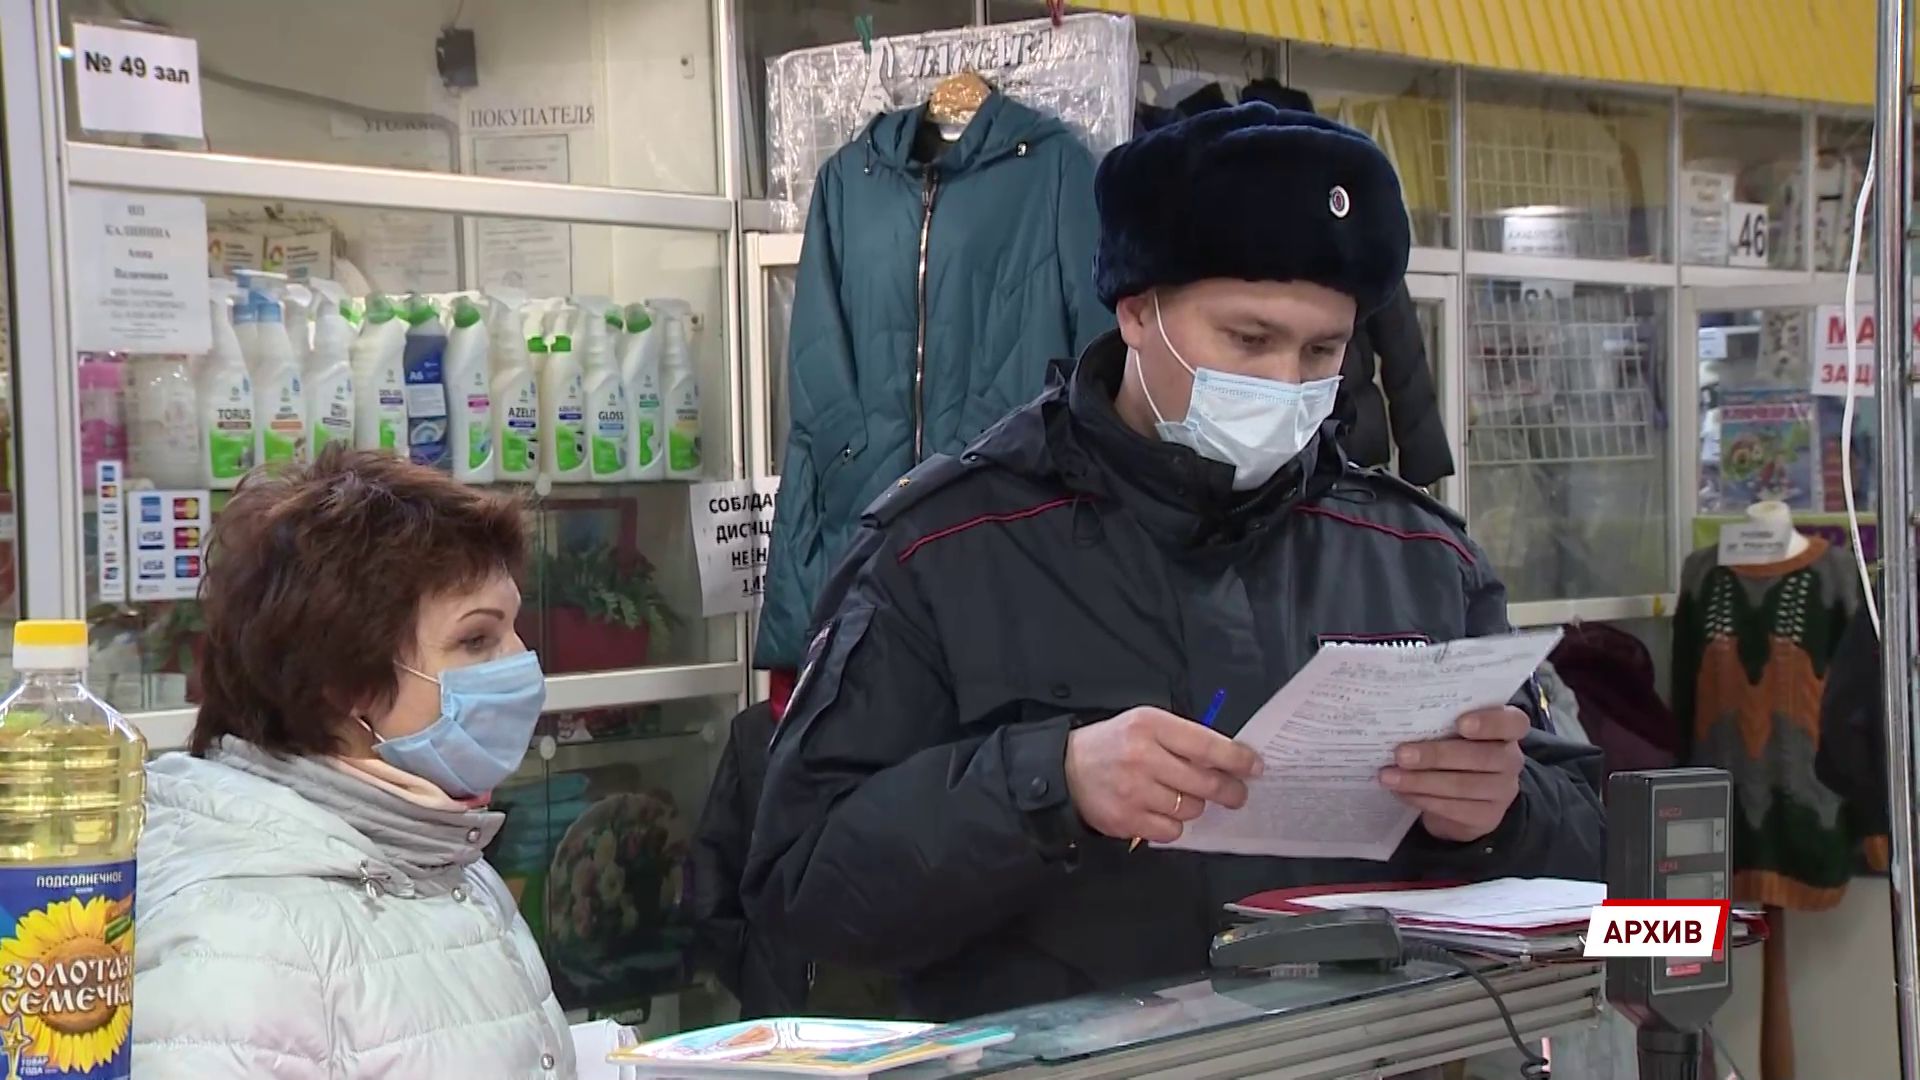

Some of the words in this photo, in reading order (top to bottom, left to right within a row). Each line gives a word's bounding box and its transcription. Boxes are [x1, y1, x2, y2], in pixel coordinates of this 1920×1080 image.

[120, 55, 147, 78] 49
[153, 65, 190, 84] зал
[470, 105, 595, 128] ПОКУПАТЕЛЯ
[1737, 213, 1766, 258] 46
[216, 408, 252, 420] TORUS
[508, 407, 537, 418] AZELIT
[598, 411, 625, 420] GLOSS
[142, 531, 164, 542] VISA
[143, 560, 165, 570] VISA
[36, 870, 123, 888] ПОДСОЛНЕЧНОЕ
[3, 955, 132, 988] ЗОЛОТАЯ
[1, 984, 131, 1014] СЕМЕЧКИ
